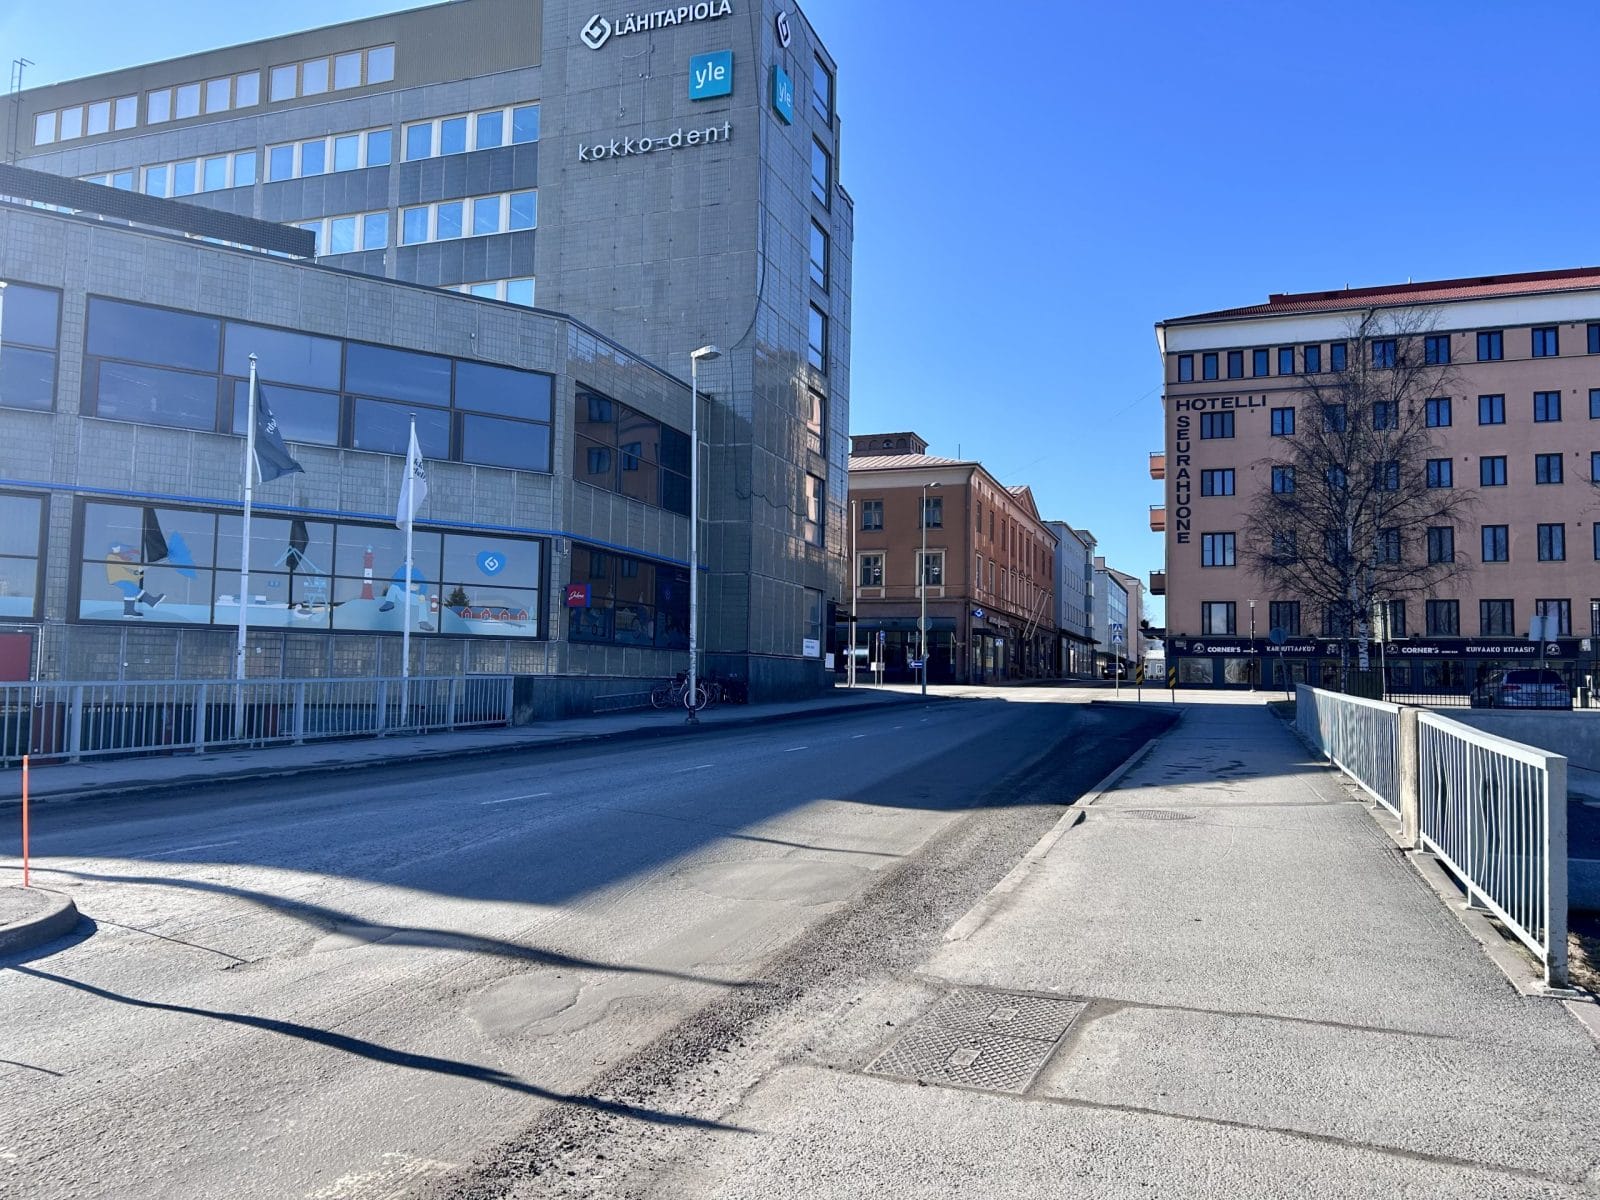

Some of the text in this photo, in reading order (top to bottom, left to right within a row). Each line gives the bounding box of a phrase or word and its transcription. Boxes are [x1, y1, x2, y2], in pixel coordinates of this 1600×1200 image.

[615, 0, 732, 36] LÄHITAPIOLA
[695, 62, 725, 89] yle
[779, 82, 791, 108] yle
[1176, 395, 1266, 411] HOTELLI
[1176, 415, 1192, 544] SEURAHUONE
